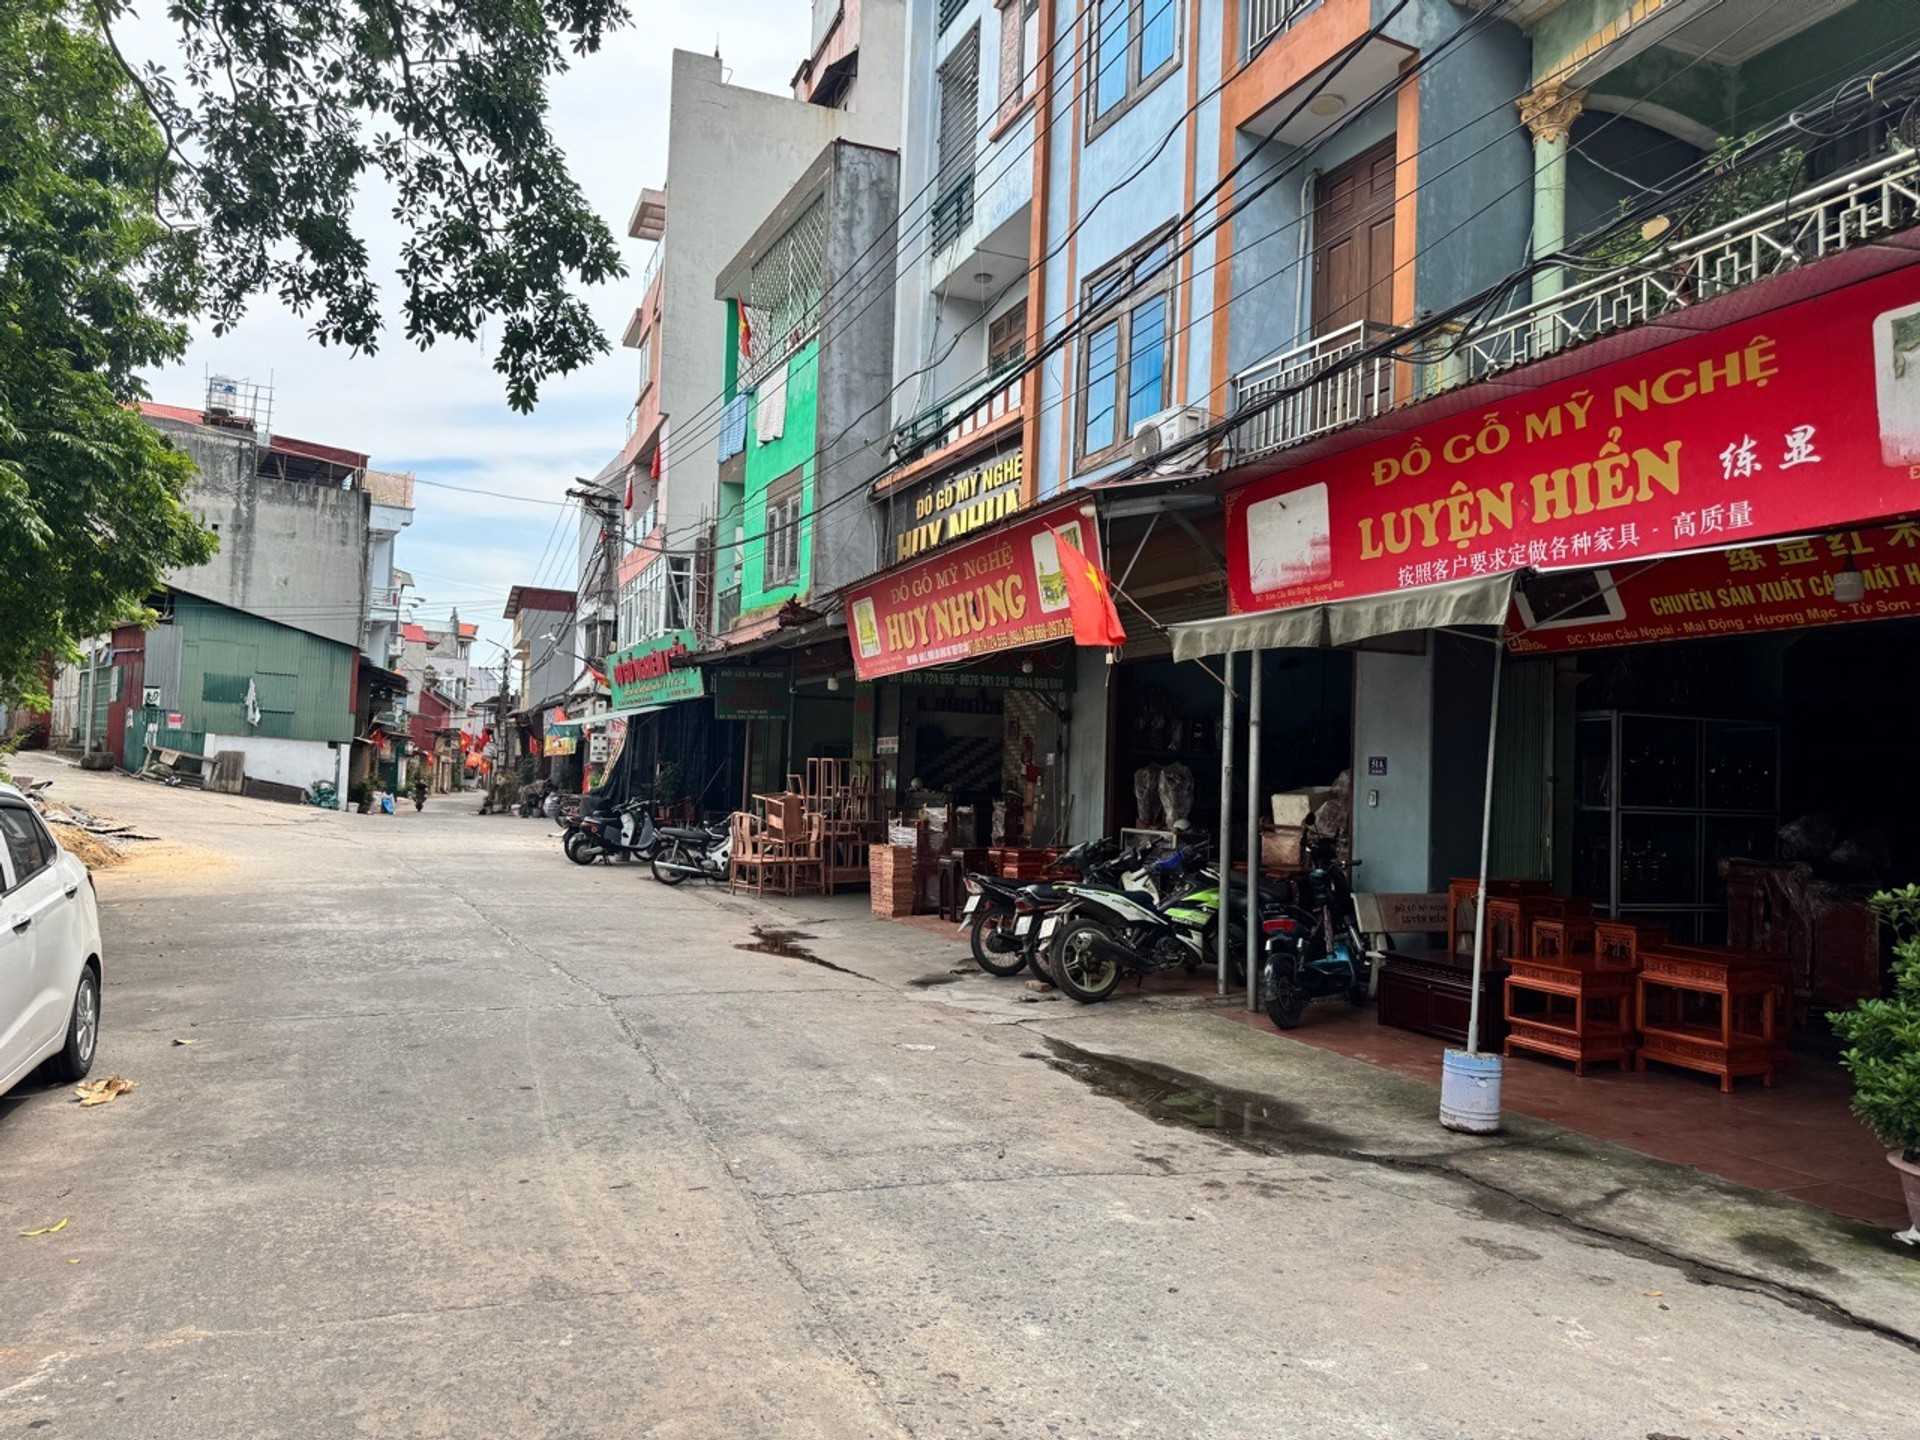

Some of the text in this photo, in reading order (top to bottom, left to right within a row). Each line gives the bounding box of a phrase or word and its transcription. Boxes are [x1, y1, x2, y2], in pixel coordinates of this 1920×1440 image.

[1372, 335, 1778, 486] ĐỒ GỖ MỸ NGHỆ
[1357, 426, 1682, 560] LUYỆN HIỂN
[963, 541, 1014, 581] NGHỆ
[1398, 500, 1754, 587] 按照客户要求定做各种家具 高质量
[885, 574, 1026, 652] HUY NHUNG
[1566, 633, 1588, 645] ĐC:
[1590, 630, 1614, 643] Xóm
[1684, 620, 1706, 633] Mai
[1708, 617, 1744, 632] Động
[1753, 610, 1804, 626] Hương
[1805, 606, 1838, 620] Mạc
[1848, 601, 1873, 615] Từ
[1876, 599, 1910, 613] Sơn
[1650, 587, 1716, 617] CHUYÊN
[1718, 579, 1755, 607] SẢN
[1756, 571, 1805, 604] XUẤT
[1808, 570, 1835, 598] CÁ
